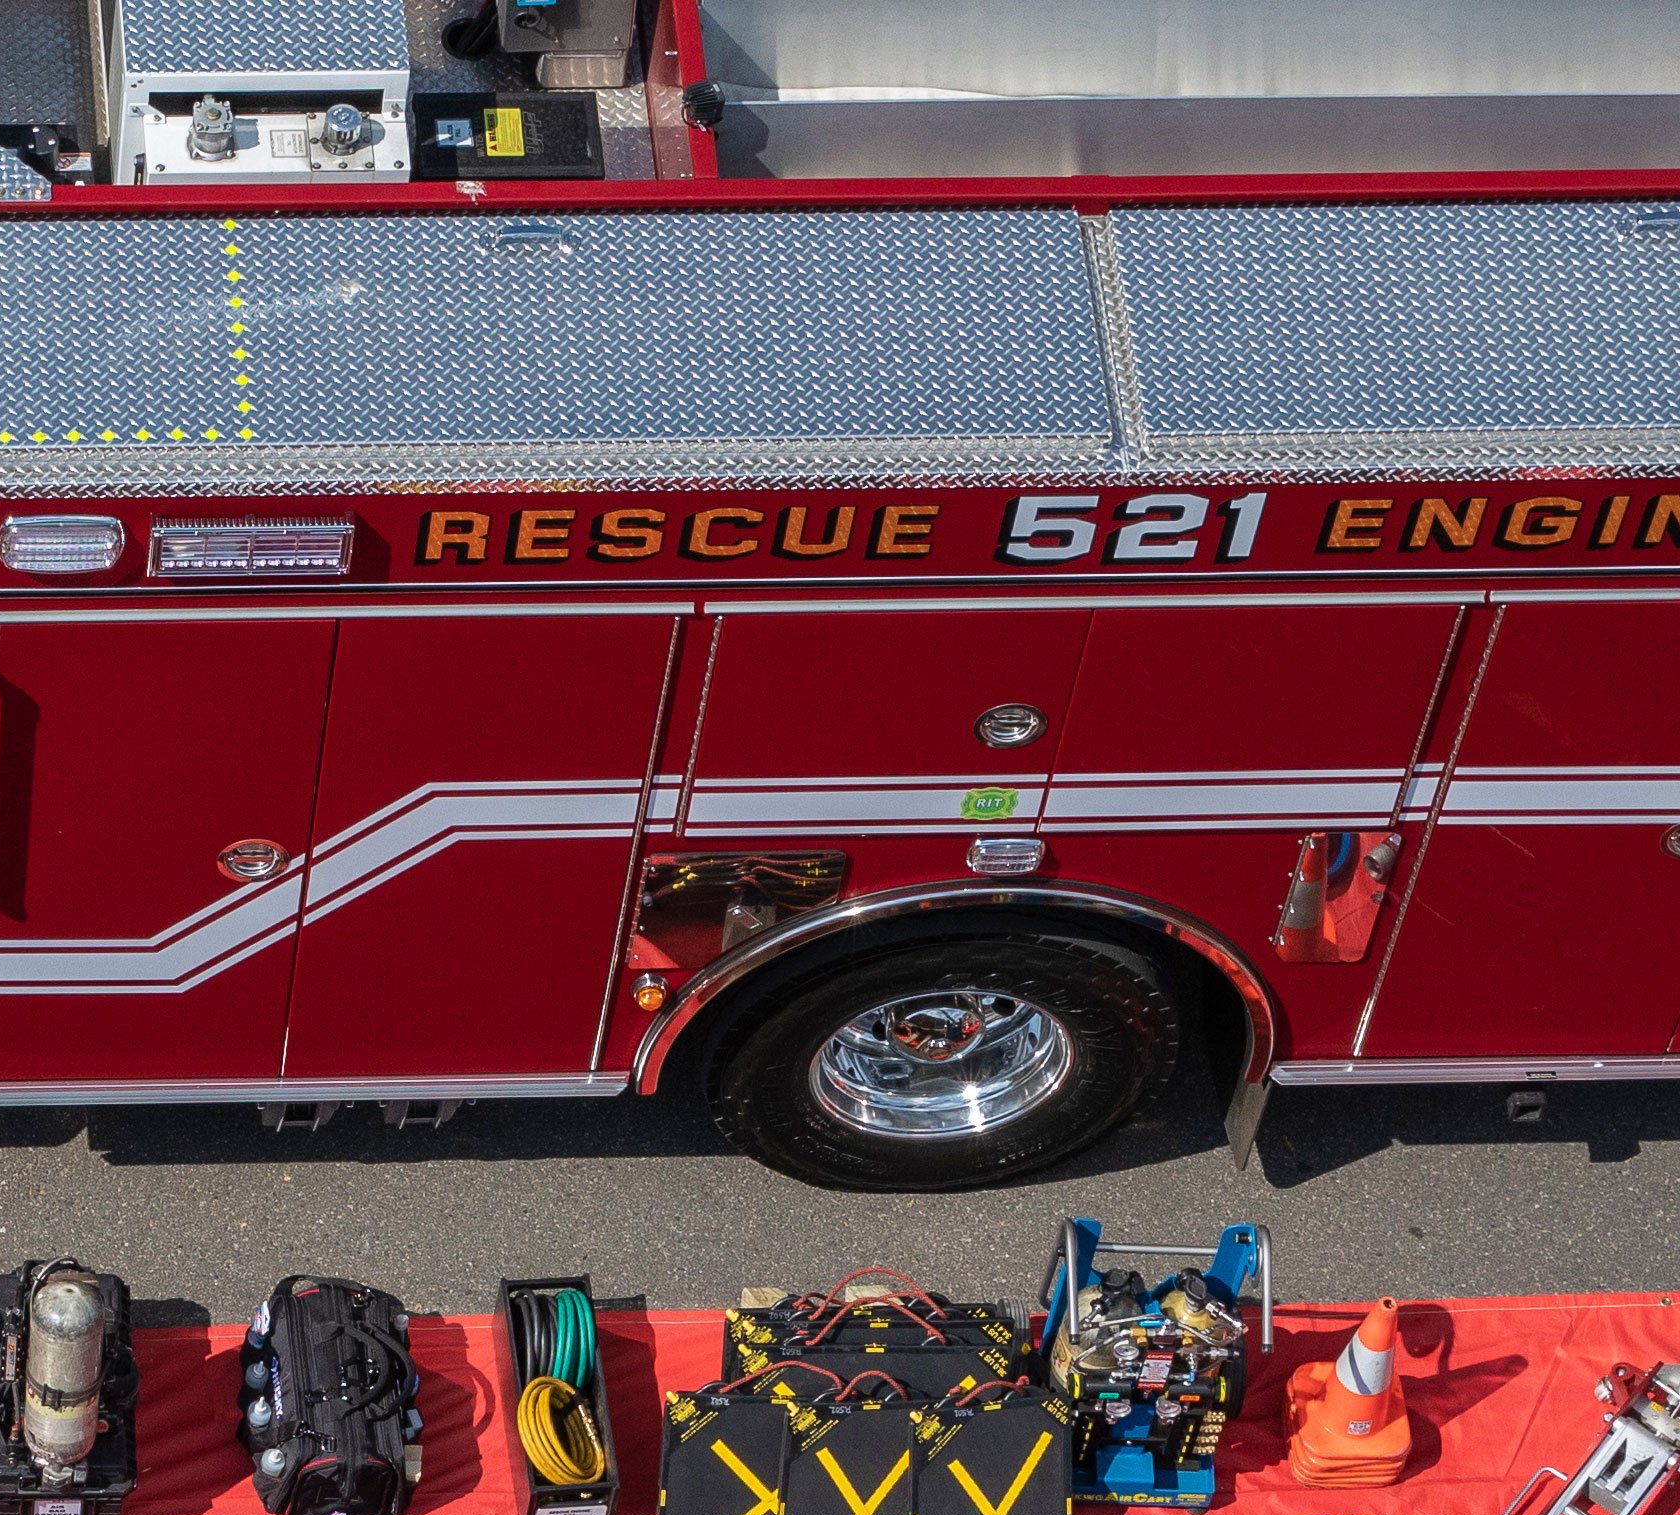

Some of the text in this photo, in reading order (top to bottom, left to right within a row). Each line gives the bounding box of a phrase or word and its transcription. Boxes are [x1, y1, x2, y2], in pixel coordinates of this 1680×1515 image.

[418, 504, 940, 563] RESCUE
[998, 491, 1268, 564] 521
[976, 797, 1003, 809] RIT
